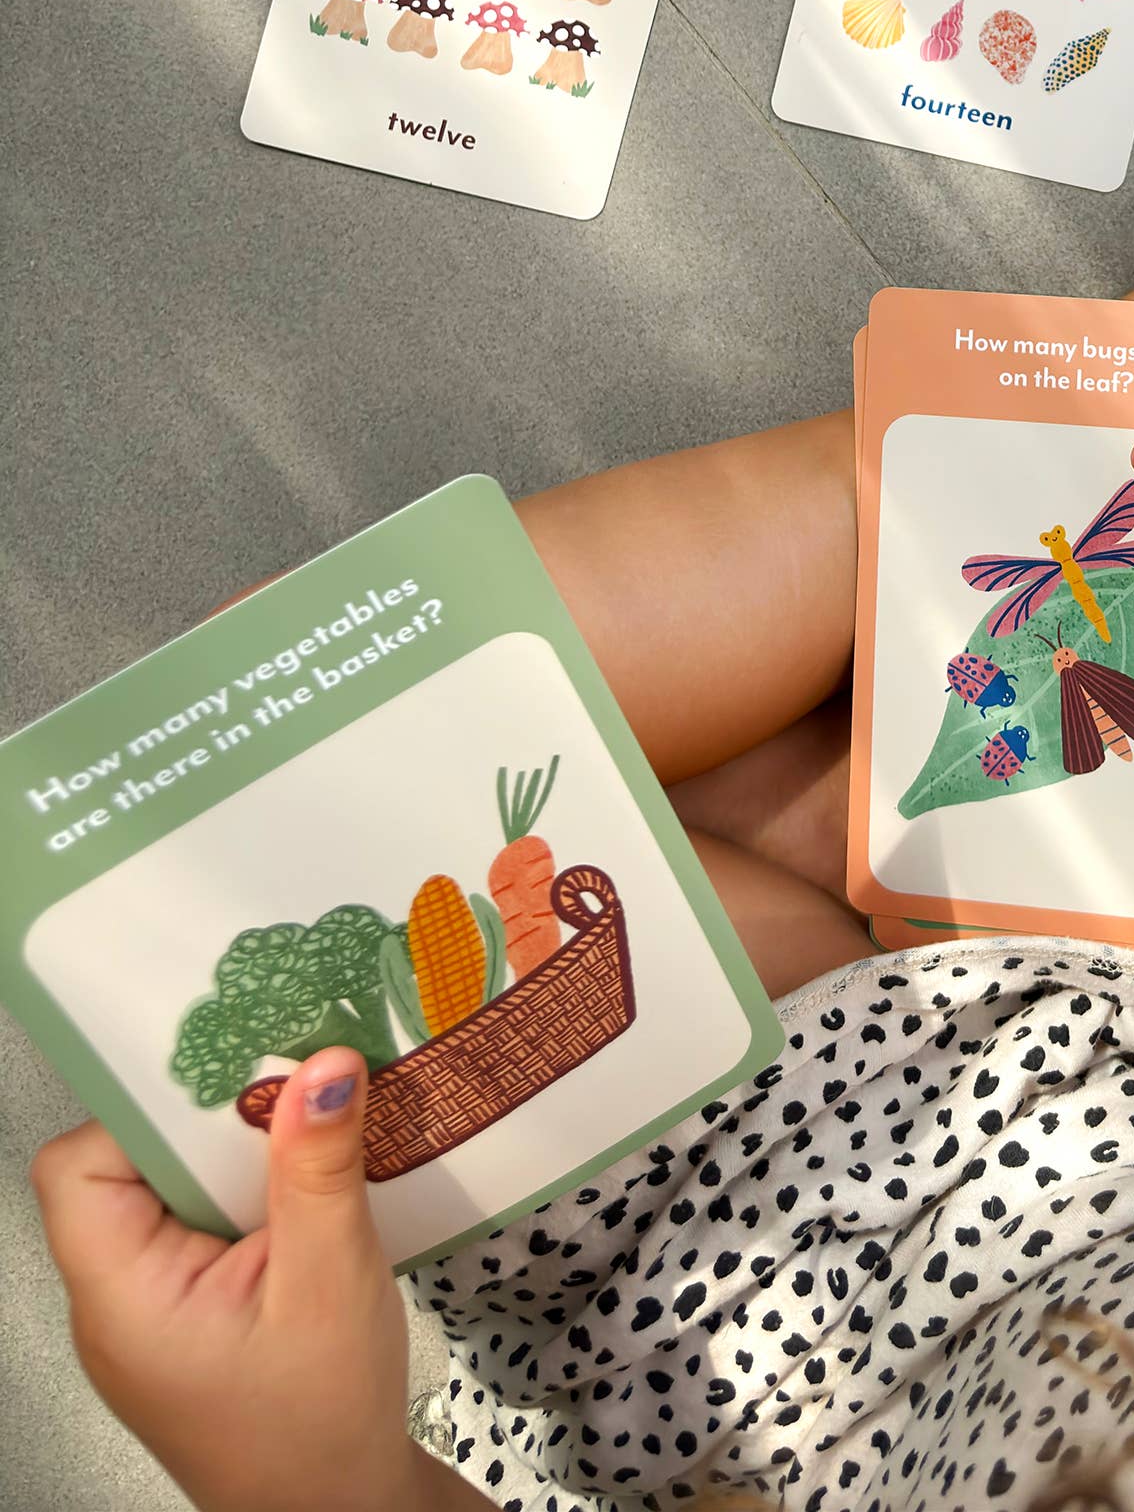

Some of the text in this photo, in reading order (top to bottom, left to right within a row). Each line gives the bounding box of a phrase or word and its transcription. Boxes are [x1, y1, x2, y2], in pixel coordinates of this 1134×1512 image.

[901, 84, 1013, 130] fourteen
[388, 112, 477, 150] twelve
[954, 328, 1008, 352] How
[1013, 338, 1077, 363] many
[999, 366, 1134, 393] on the leaf?
[25, 576, 420, 815] How many vegetables
[47, 597, 445, 853] are there in the basket?
